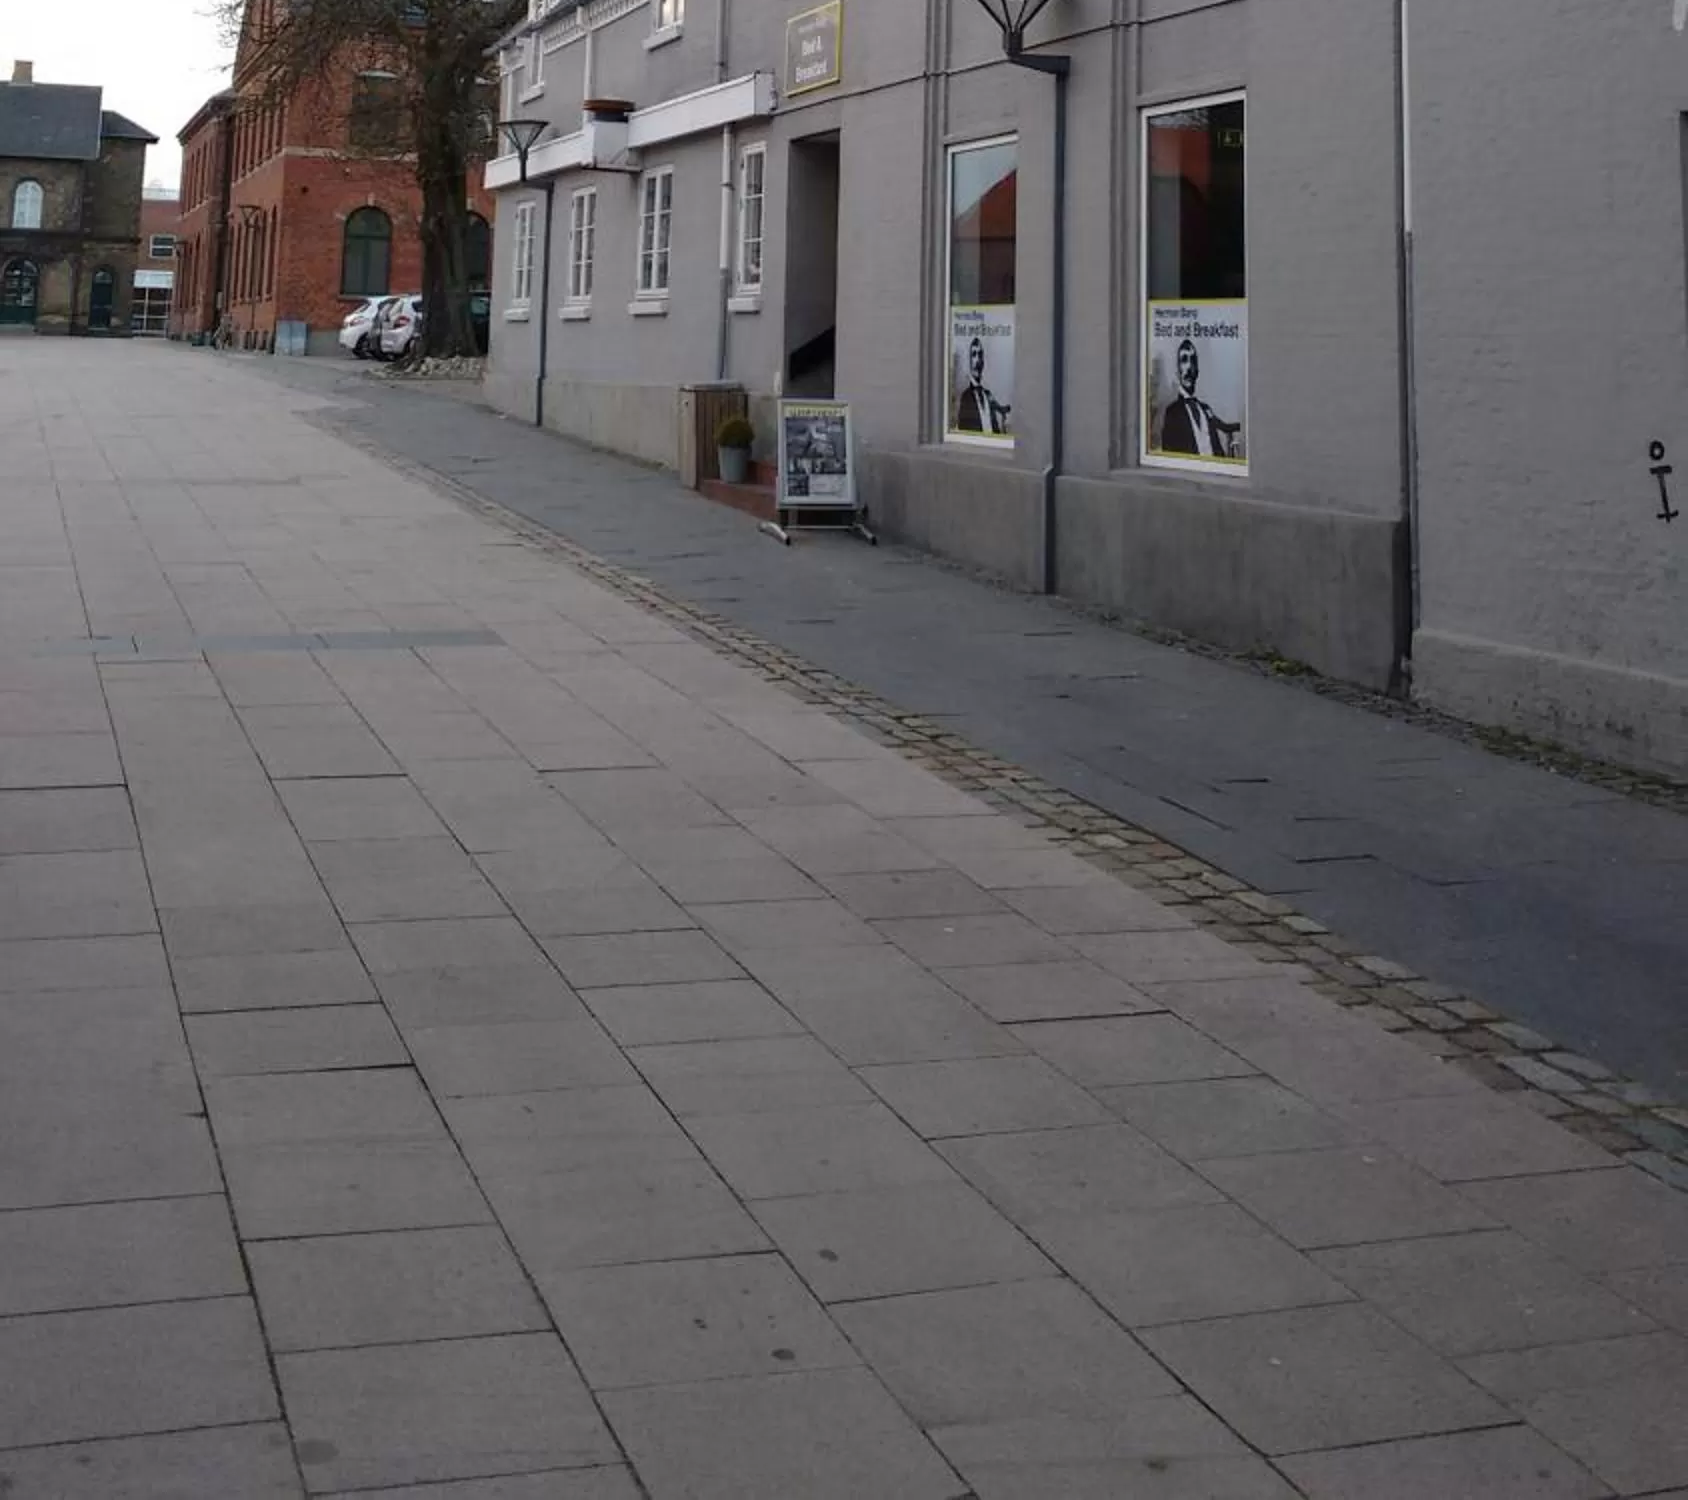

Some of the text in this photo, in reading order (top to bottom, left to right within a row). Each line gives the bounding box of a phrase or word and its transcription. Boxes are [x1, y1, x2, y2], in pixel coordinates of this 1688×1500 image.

[1154, 321, 1239, 339] Bed and Breakfast
